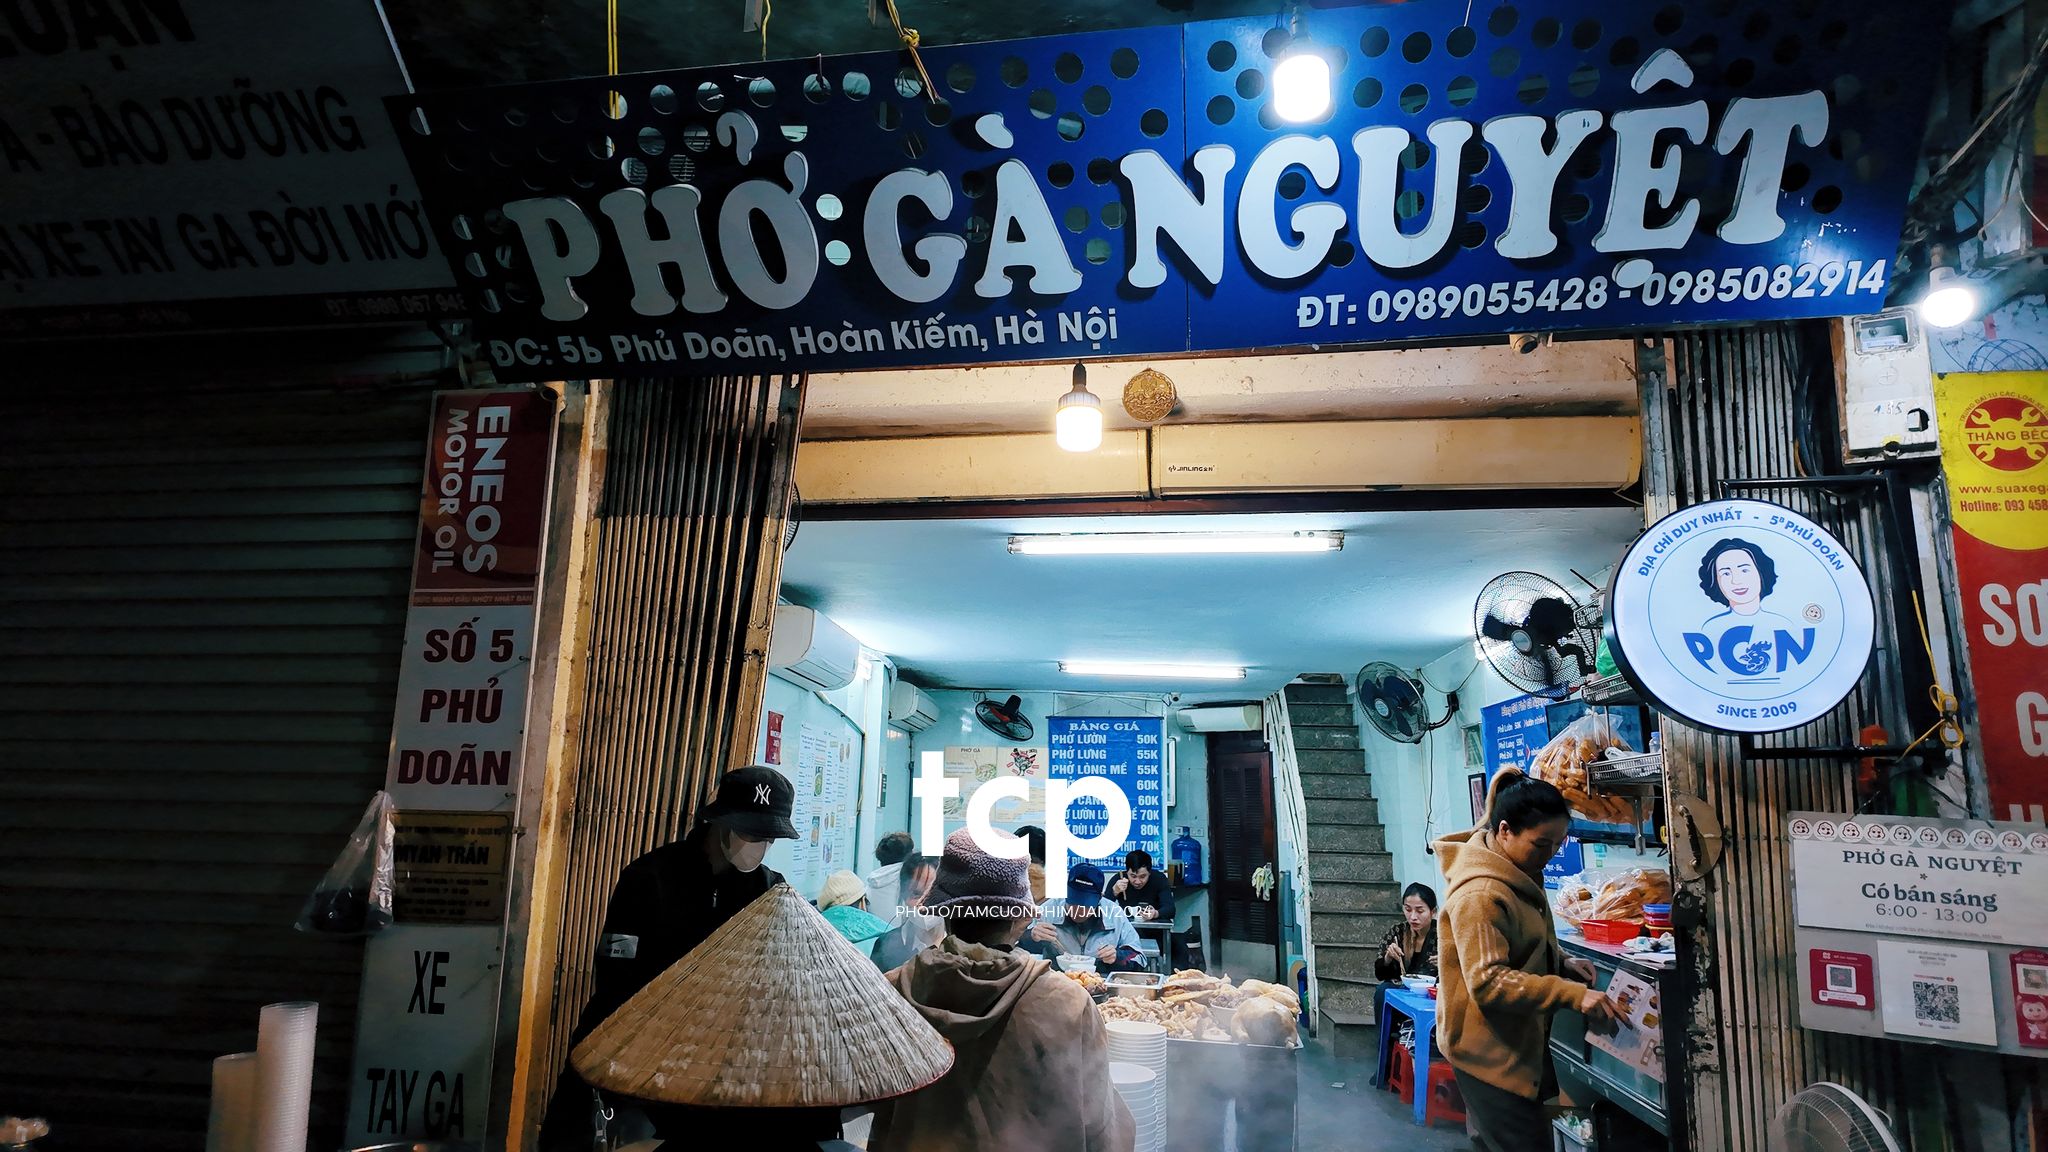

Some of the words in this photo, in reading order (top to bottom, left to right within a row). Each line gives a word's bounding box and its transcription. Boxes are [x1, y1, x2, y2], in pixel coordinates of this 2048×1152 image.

[160, 78, 368, 162] DƯỠNG
[502, 108, 819, 321] PHỞ
[863, 113, 1083, 303] GÀ
[1119, 48, 1830, 289] NGUYỆT
[83, 216, 175, 274] TAY
[177, 211, 258, 271] GA
[248, 190, 349, 267] ĐỜI
[1296, 299, 1357, 329] ĐT:
[1365, 282, 1608, 323] 0989055428
[1640, 258, 1887, 308] 0985082914
[490, 337, 554, 367] ĐC:
[613, 328, 676, 363] Phủ
[690, 326, 785, 360] Doãn,
[794, 320, 882, 354] Hoàn
[896, 312, 988, 352] Kiếm,
[995, 309, 1043, 344] Hà
[1058, 305, 1119, 349] Nội
[437, 408, 470, 516] MOTOR
[462, 405, 512, 573] ENEOS
[1960, 500, 2002, 512] Hotline:
[2004, 500, 2025, 512] 093
[431, 525, 457, 573] OIL
[1638, 553, 1657, 577] ĐỊA
[1654, 530, 1674, 554] CHỈ
[1672, 519, 1699, 540] DUY
[1702, 506, 1742, 525] NHẤT
[1785, 520, 1814, 541] PHỦ
[1812, 537, 1845, 571] DOÃN
[423, 616, 481, 663] SỐ
[490, 629, 514, 663] 5
[420, 677, 504, 723] PHỦ
[1716, 704, 1757, 719] SINCE
[1762, 701, 1798, 718] 2009
[1051, 731, 1074, 744] PHỞ
[1077, 732, 1107, 744] LƯỜN
[1137, 735, 1158, 745] 50K
[1069, 721, 1110, 731] BẢNG
[1114, 721, 1140, 731] GIÁ
[396, 744, 511, 786] DOÃN
[1051, 746, 1074, 759] PHỞ
[1077, 749, 1107, 760] LƯNG
[1137, 750, 1158, 760] 55K
[1051, 761, 1074, 775] PHỞ
[1077, 763, 1107, 775] LÒNG
[1137, 765, 1158, 775] 55K
[1137, 780, 1159, 791] 60K
[1138, 796, 1159, 806] 60K
[1140, 809, 1160, 821] 70K
[1140, 825, 1160, 836] 80K
[1140, 841, 1160, 852] 70K
[1842, 848, 1885, 865] PHỞ
[1890, 851, 1919, 868] GÀ
[1928, 855, 2022, 877] NGUYỆT
[1862, 883, 1890, 899] Có
[1894, 883, 1935, 904] bán
[1940, 885, 1998, 912] sáng
[1876, 903, 1917, 918] 6:00
[1935, 908, 1988, 924] 13:00
[407, 950, 450, 1015] XE
[366, 1067, 419, 1134] TAY
[424, 1072, 465, 1137] GA
